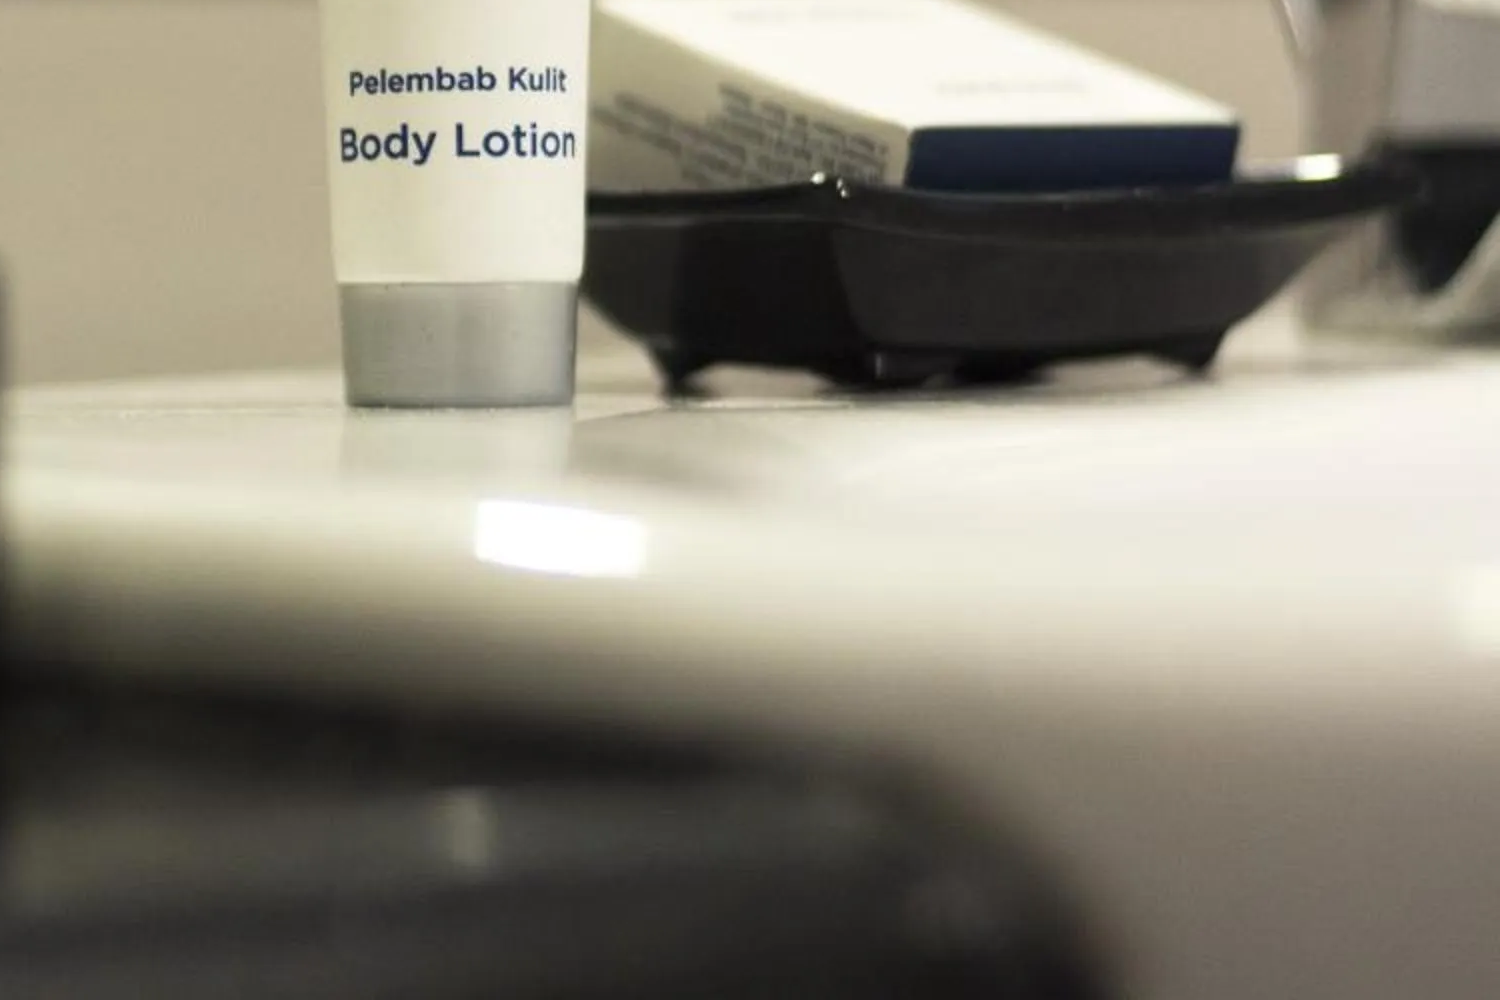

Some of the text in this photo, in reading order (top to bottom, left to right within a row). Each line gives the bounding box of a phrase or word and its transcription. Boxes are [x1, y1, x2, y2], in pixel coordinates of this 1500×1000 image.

[349, 66, 567, 96] Pelembab Kulit
[339, 122, 576, 165] Body Lotion
